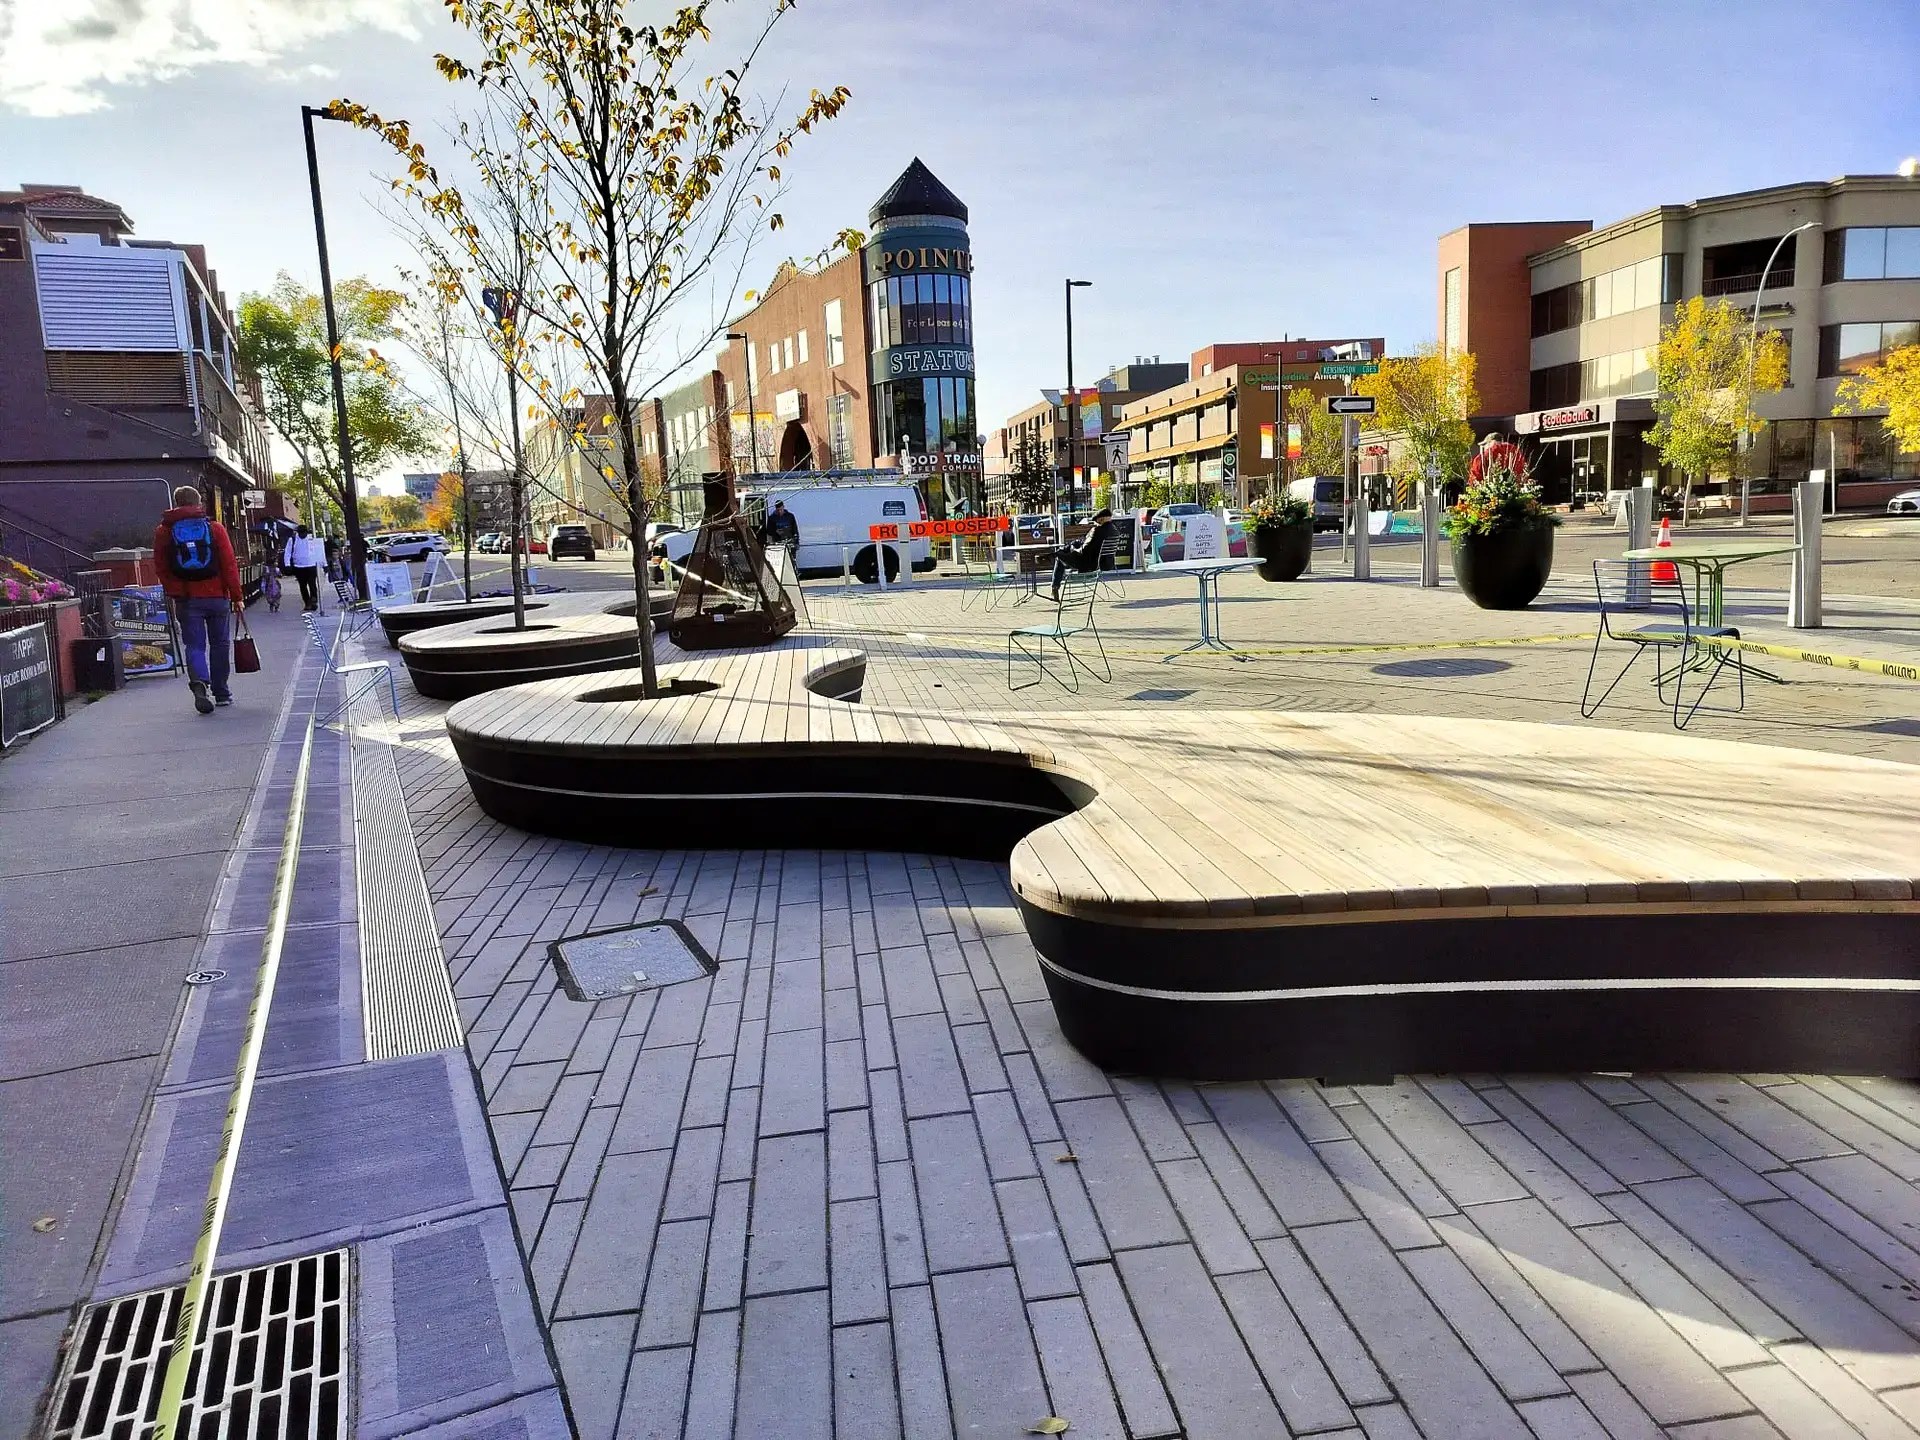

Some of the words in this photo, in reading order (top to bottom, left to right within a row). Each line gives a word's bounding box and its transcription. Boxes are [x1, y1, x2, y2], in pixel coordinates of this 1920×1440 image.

[1323, 365, 1356, 374] KENSINGTON
[1260, 383, 1293, 391] Insurnce
[1541, 409, 1591, 427] Scotiabank
[934, 519, 999, 533] CLOSED
[114, 620, 143, 630] COMING
[1739, 642, 1770, 655] CAUTION
[1801, 652, 1834, 666] CAUTION
[1882, 663, 1917, 680] CAUTION
